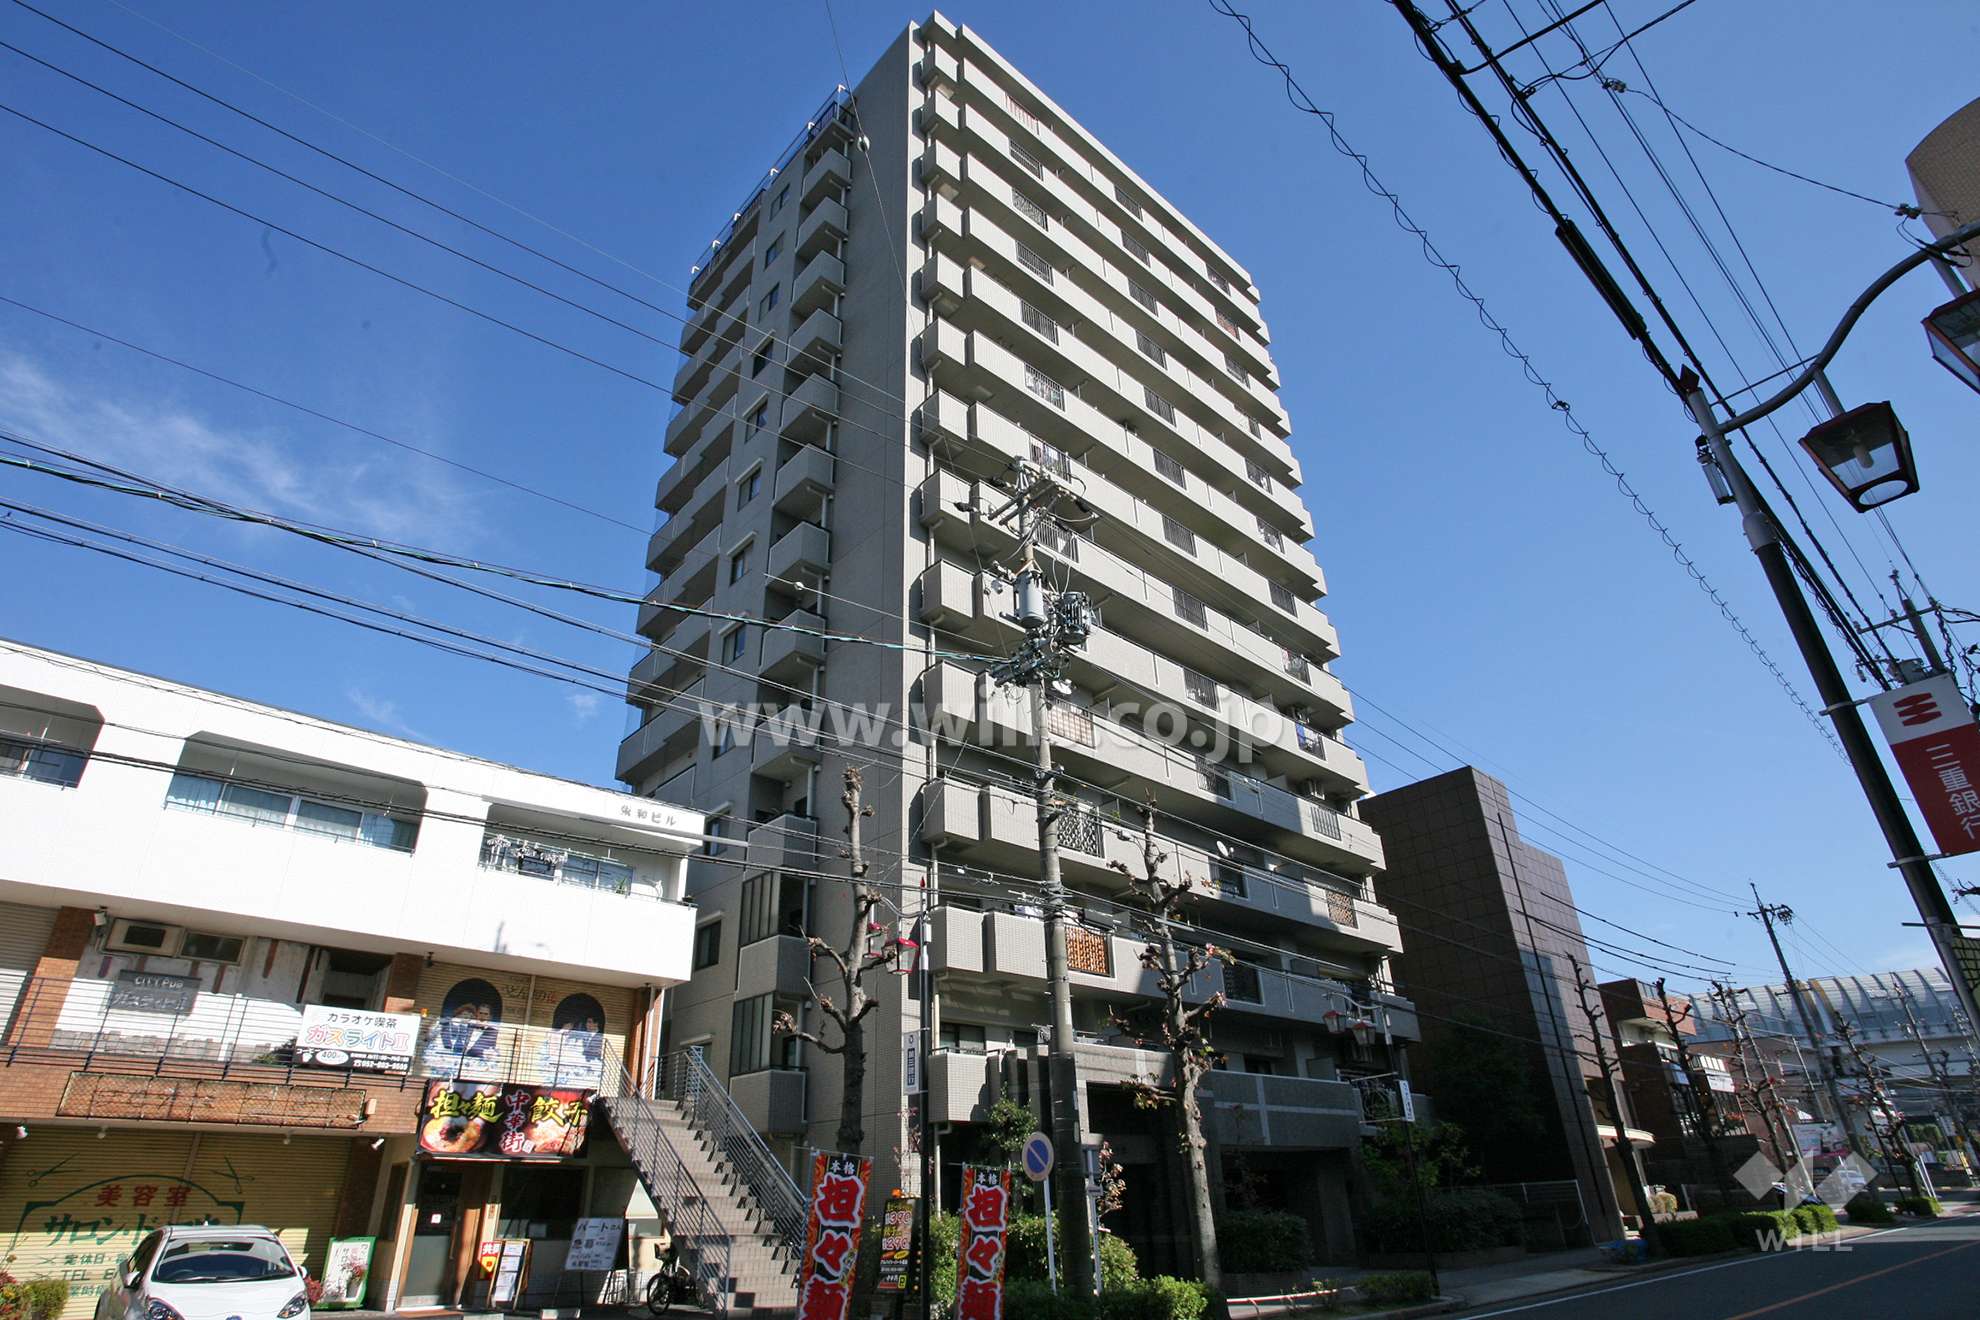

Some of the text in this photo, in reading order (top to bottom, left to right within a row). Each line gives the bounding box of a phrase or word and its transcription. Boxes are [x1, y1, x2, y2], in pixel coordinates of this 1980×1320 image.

[327, 1012, 398, 1029] カラオケ喫茶
[500, 1090, 529, 1153] 中華街
[529, 1096, 588, 1127] 餃子
[94, 1184, 192, 1208] 美容室
[61, 1269, 91, 1281] TEL
